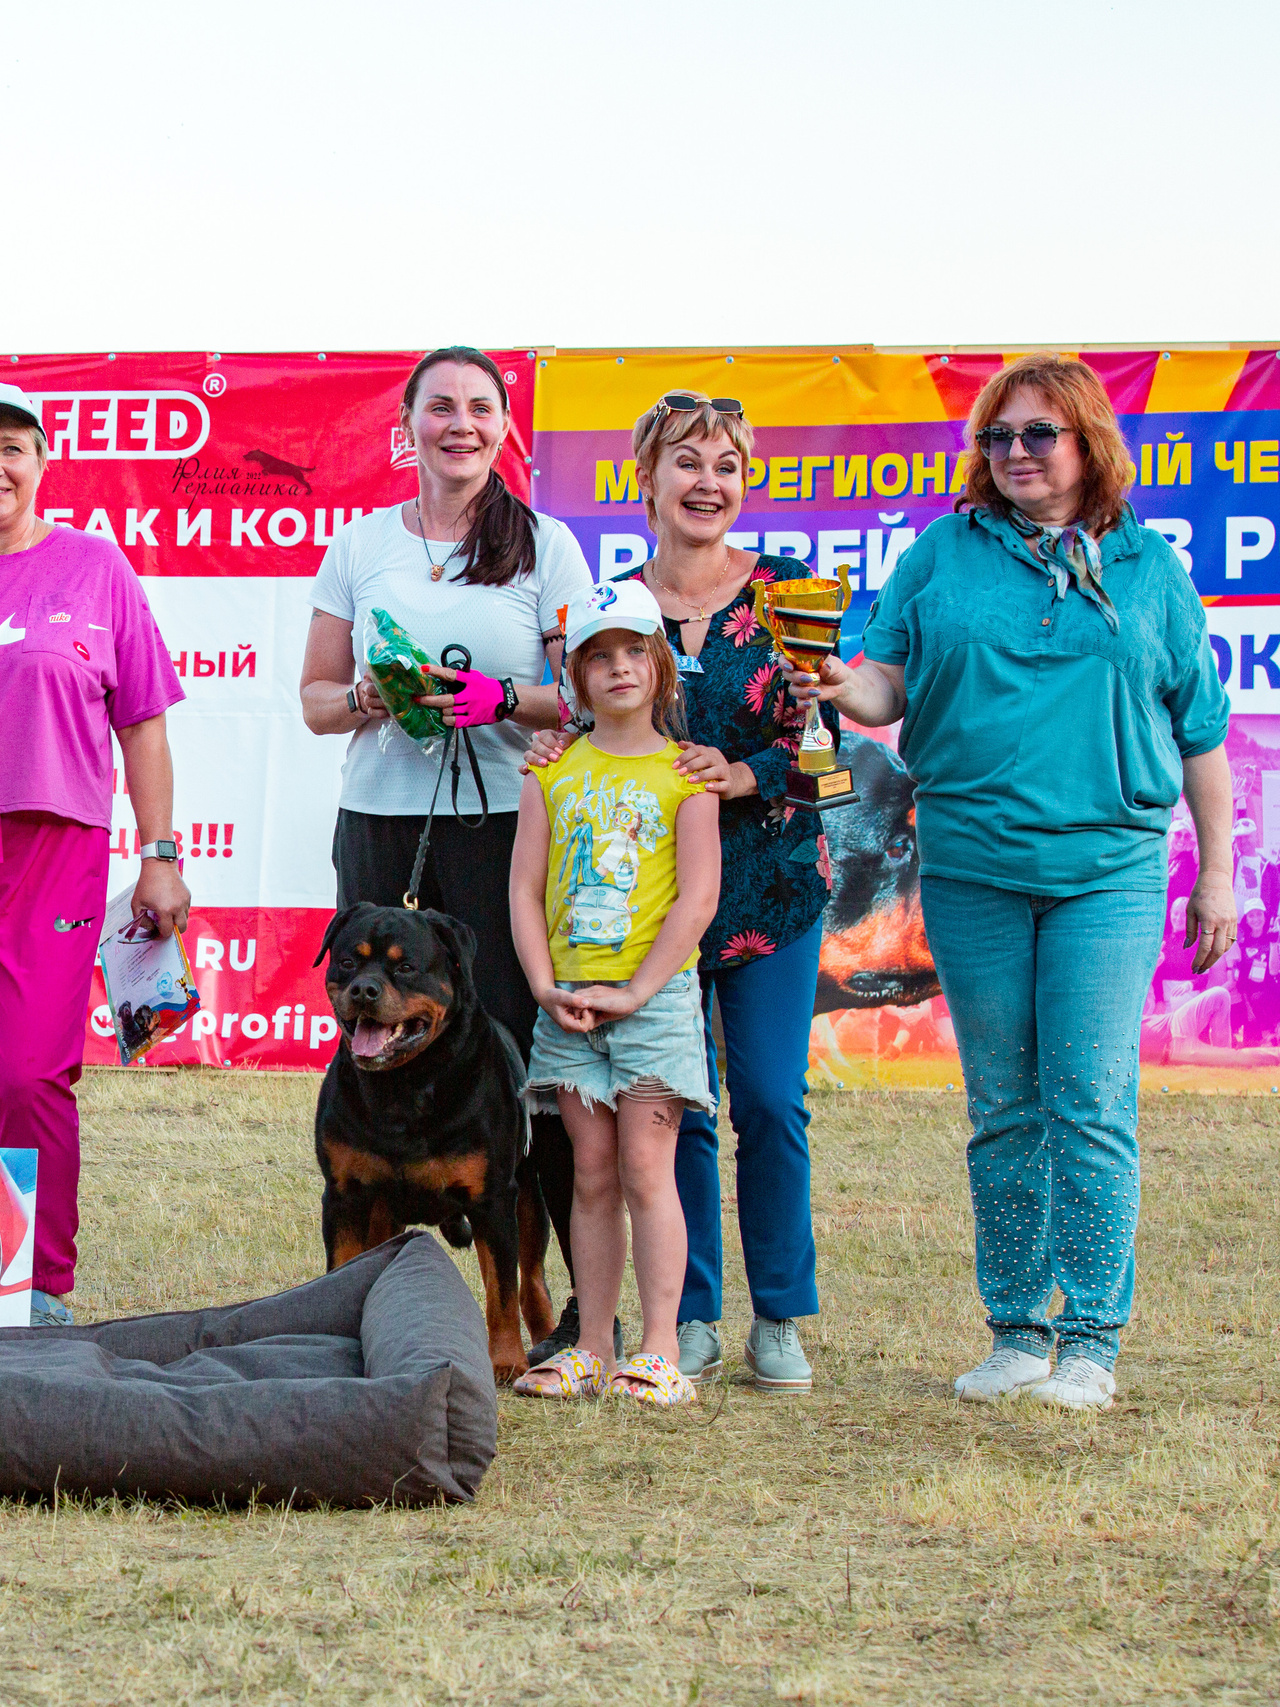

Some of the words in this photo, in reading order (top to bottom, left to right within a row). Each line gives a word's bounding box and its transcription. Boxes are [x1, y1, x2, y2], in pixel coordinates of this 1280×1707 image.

[177, 508, 212, 546] И
[231, 507, 391, 547] КОШ
[49, 612, 72, 623] nike
[161, 1004, 338, 1049] profip
